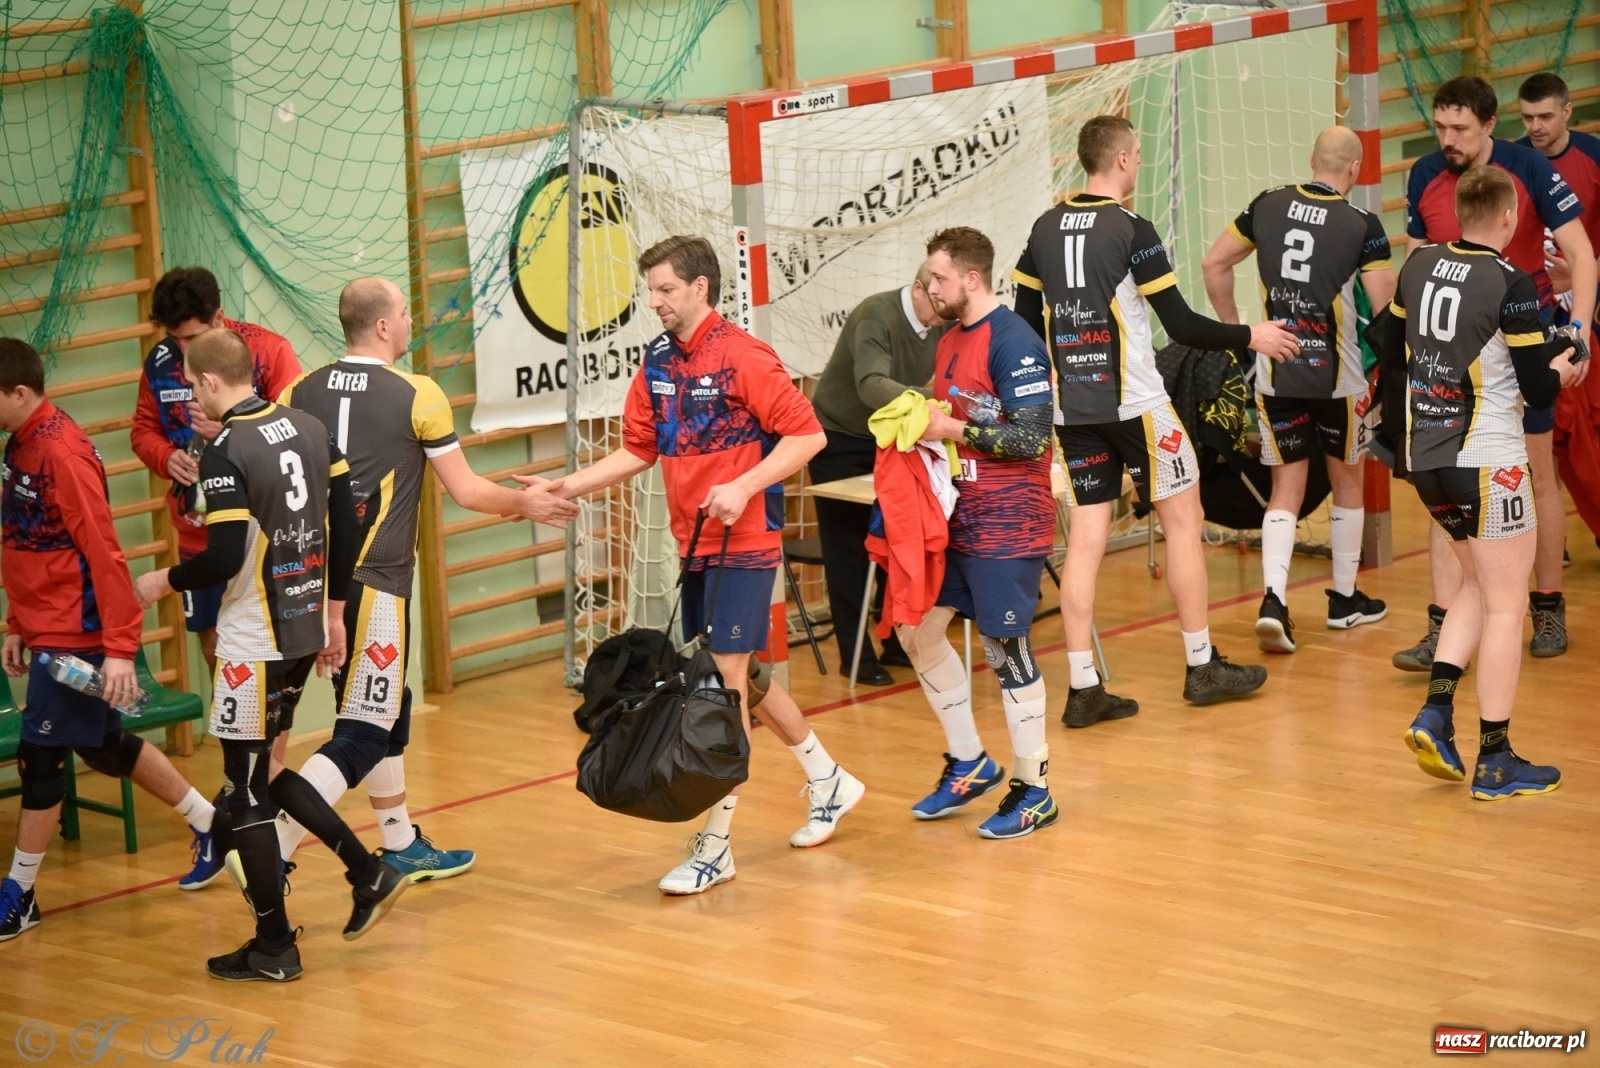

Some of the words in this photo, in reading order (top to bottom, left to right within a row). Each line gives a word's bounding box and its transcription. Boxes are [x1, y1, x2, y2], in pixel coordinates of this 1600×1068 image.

[808, 93, 834, 109] sport
[1060, 212, 1097, 230] ENTER
[1287, 199, 1328, 225] ENTER
[1064, 234, 1086, 289] 11
[1281, 228, 1315, 283] 2
[1432, 258, 1472, 283] ENTER
[1419, 281, 1462, 343] 10
[1056, 329, 1112, 347] INSTALMAG
[327, 370, 368, 392] ENTER
[257, 417, 298, 445] ENTER
[279, 449, 308, 512] 3
[1498, 470, 1517, 484] Enter
[1502, 495, 1523, 523] 10
[365, 674, 389, 704] 13
[220, 696, 237, 725] 3
